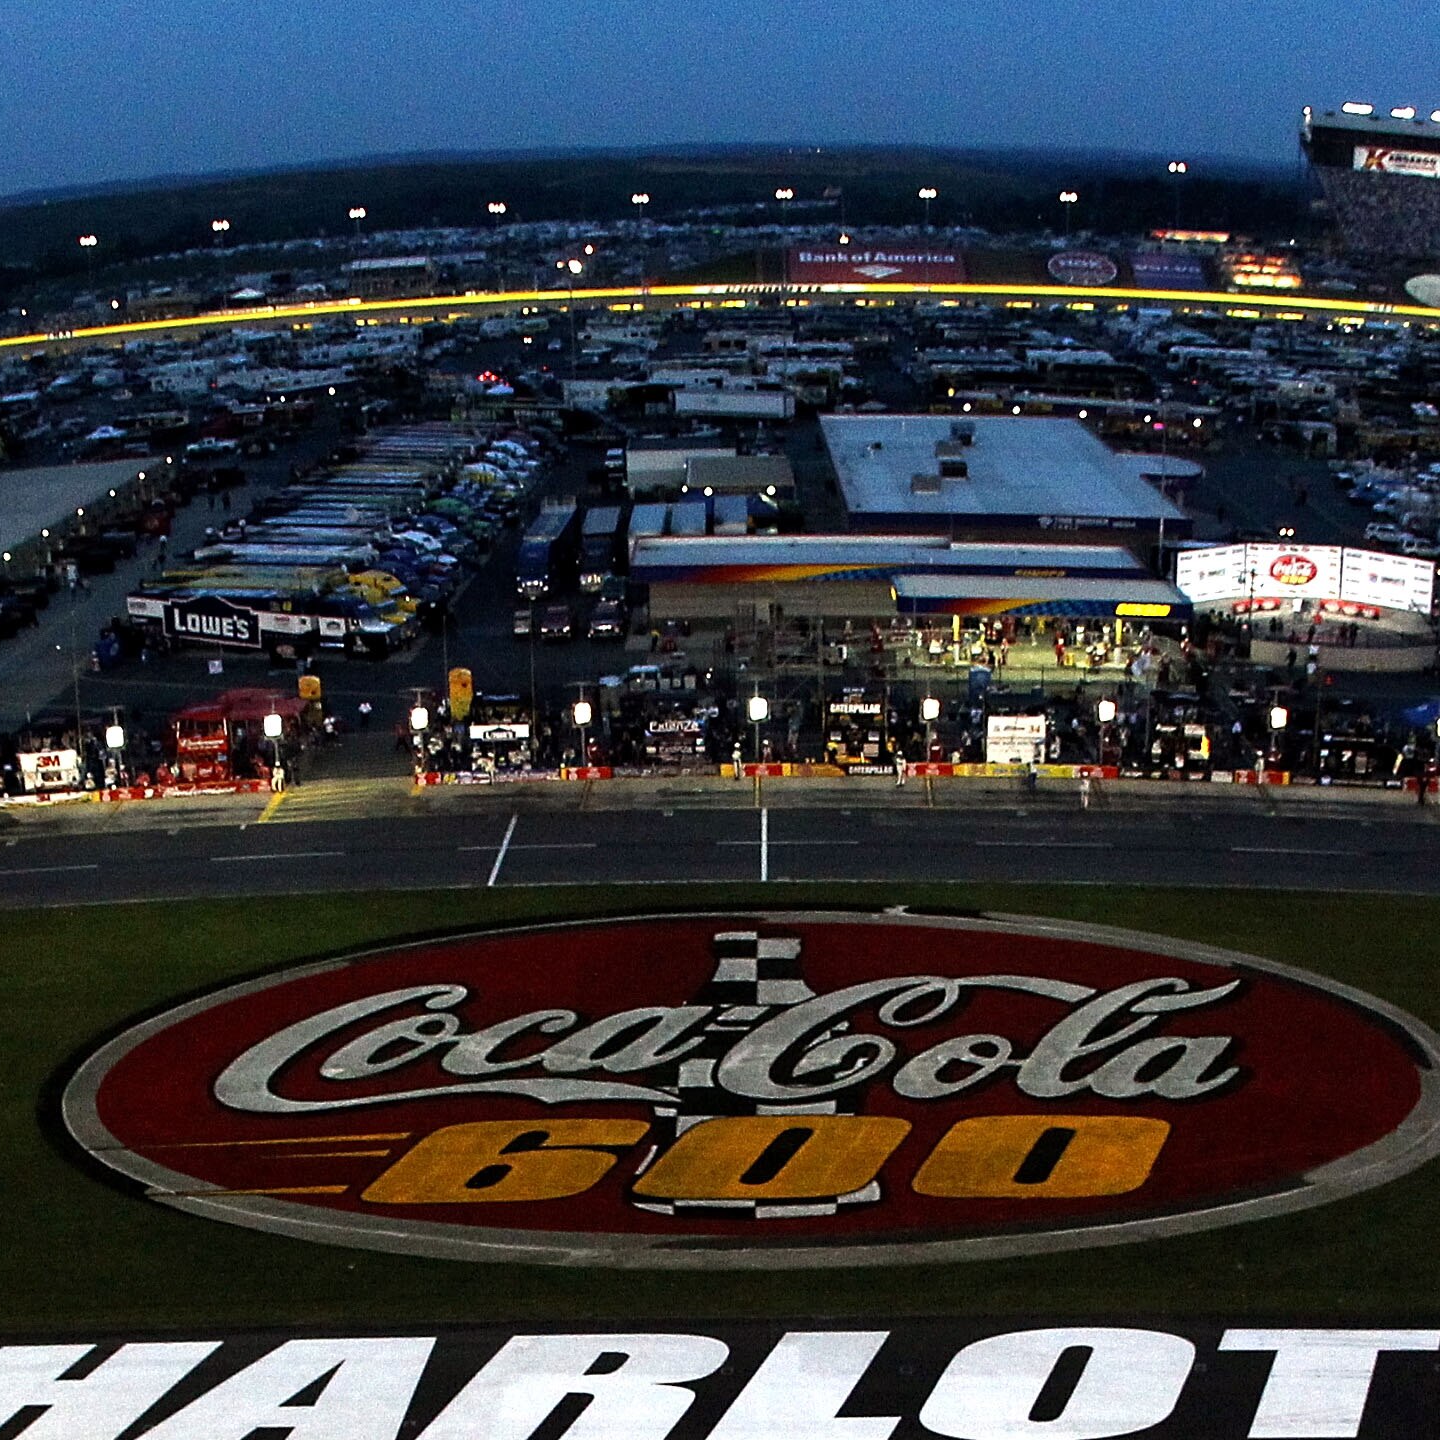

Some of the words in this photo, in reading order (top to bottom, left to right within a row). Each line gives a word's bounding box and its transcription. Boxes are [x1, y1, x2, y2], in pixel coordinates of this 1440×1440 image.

[799, 252, 848, 264] Bank
[851, 252, 865, 264] of
[866, 252, 956, 265] America
[173, 607, 250, 640] LOWE'S
[830, 703, 882, 715] CATERPILLAR
[36, 755, 60, 768] 3M
[214, 976, 1241, 1116] Coca-Cola
[359, 1113, 1171, 1204] 600
